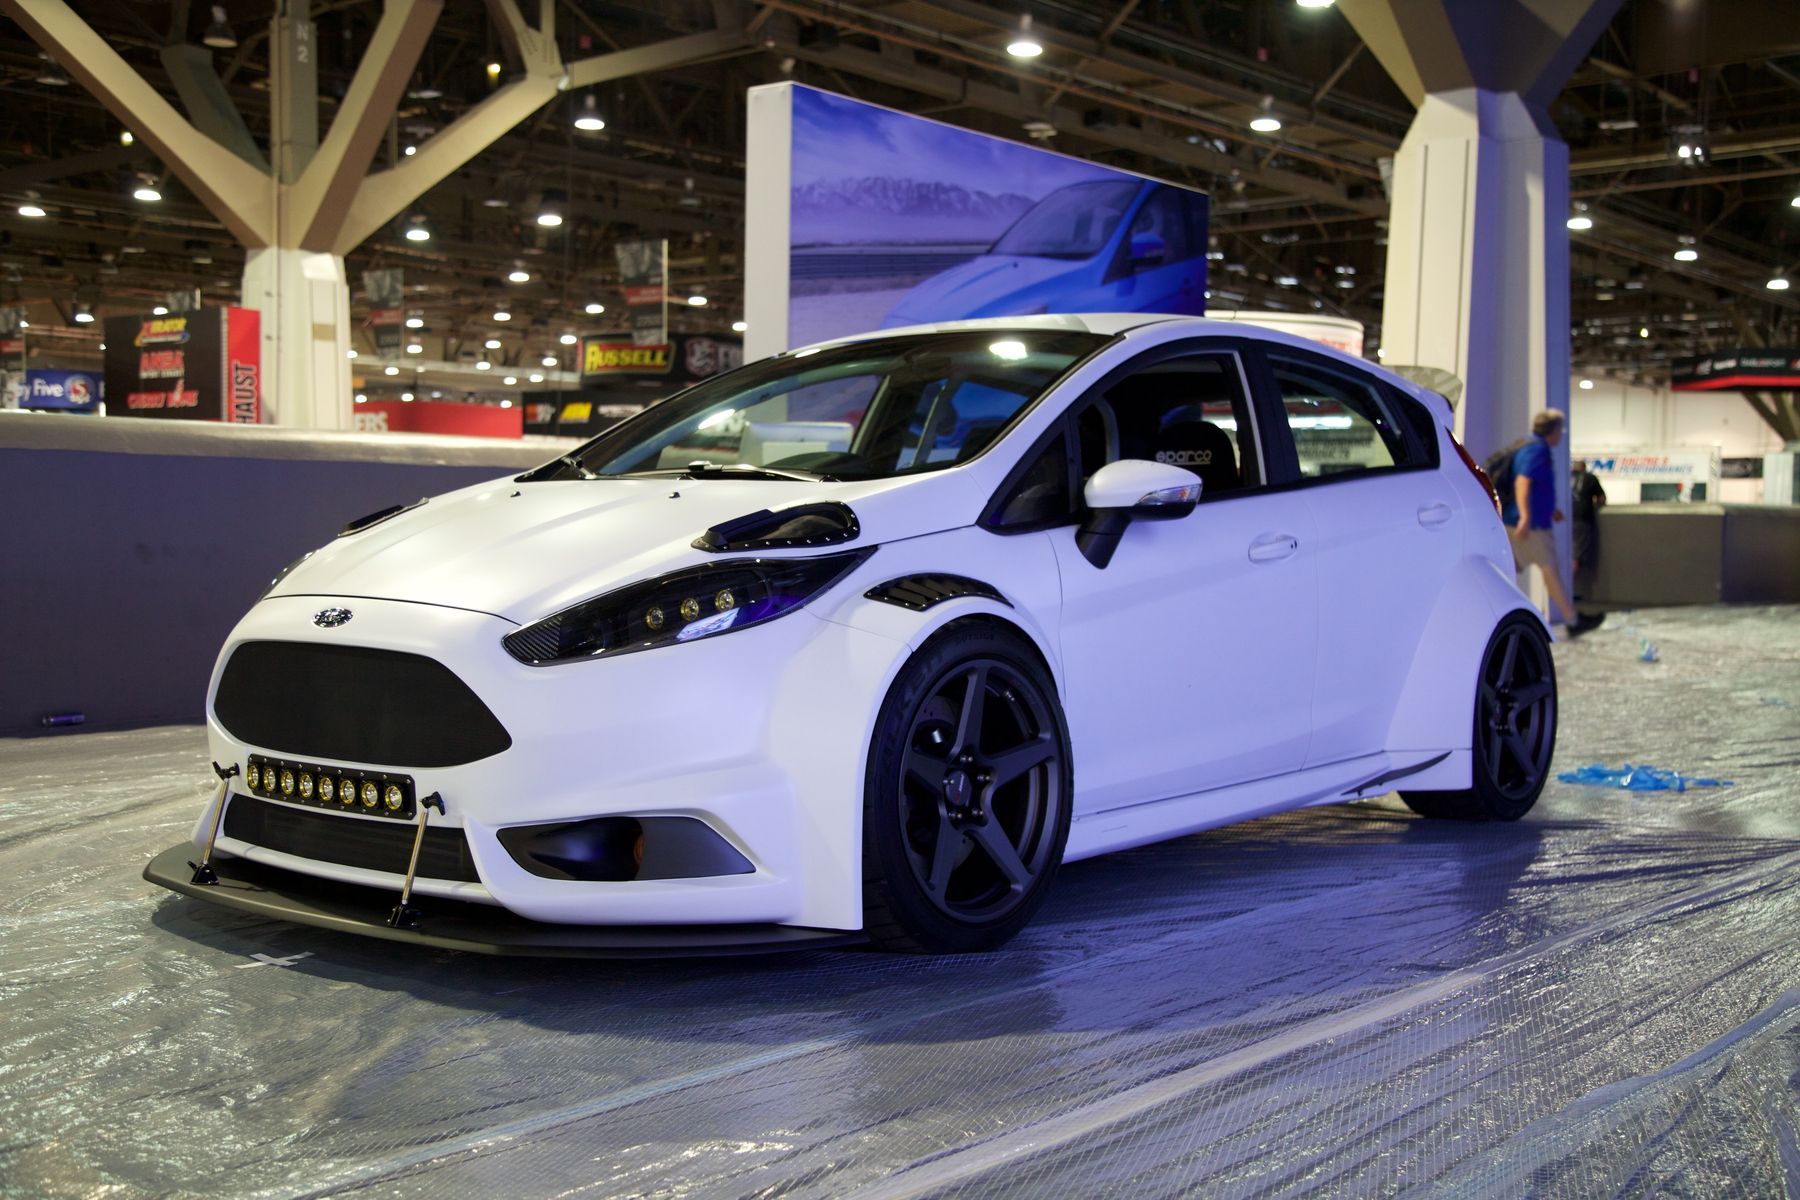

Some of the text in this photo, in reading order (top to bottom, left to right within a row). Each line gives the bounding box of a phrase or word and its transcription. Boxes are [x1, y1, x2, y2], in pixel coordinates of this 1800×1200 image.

[296, 23, 309, 63] N 2
[584, 342, 668, 373] RUSSELL
[33, 377, 65, 398] Five
